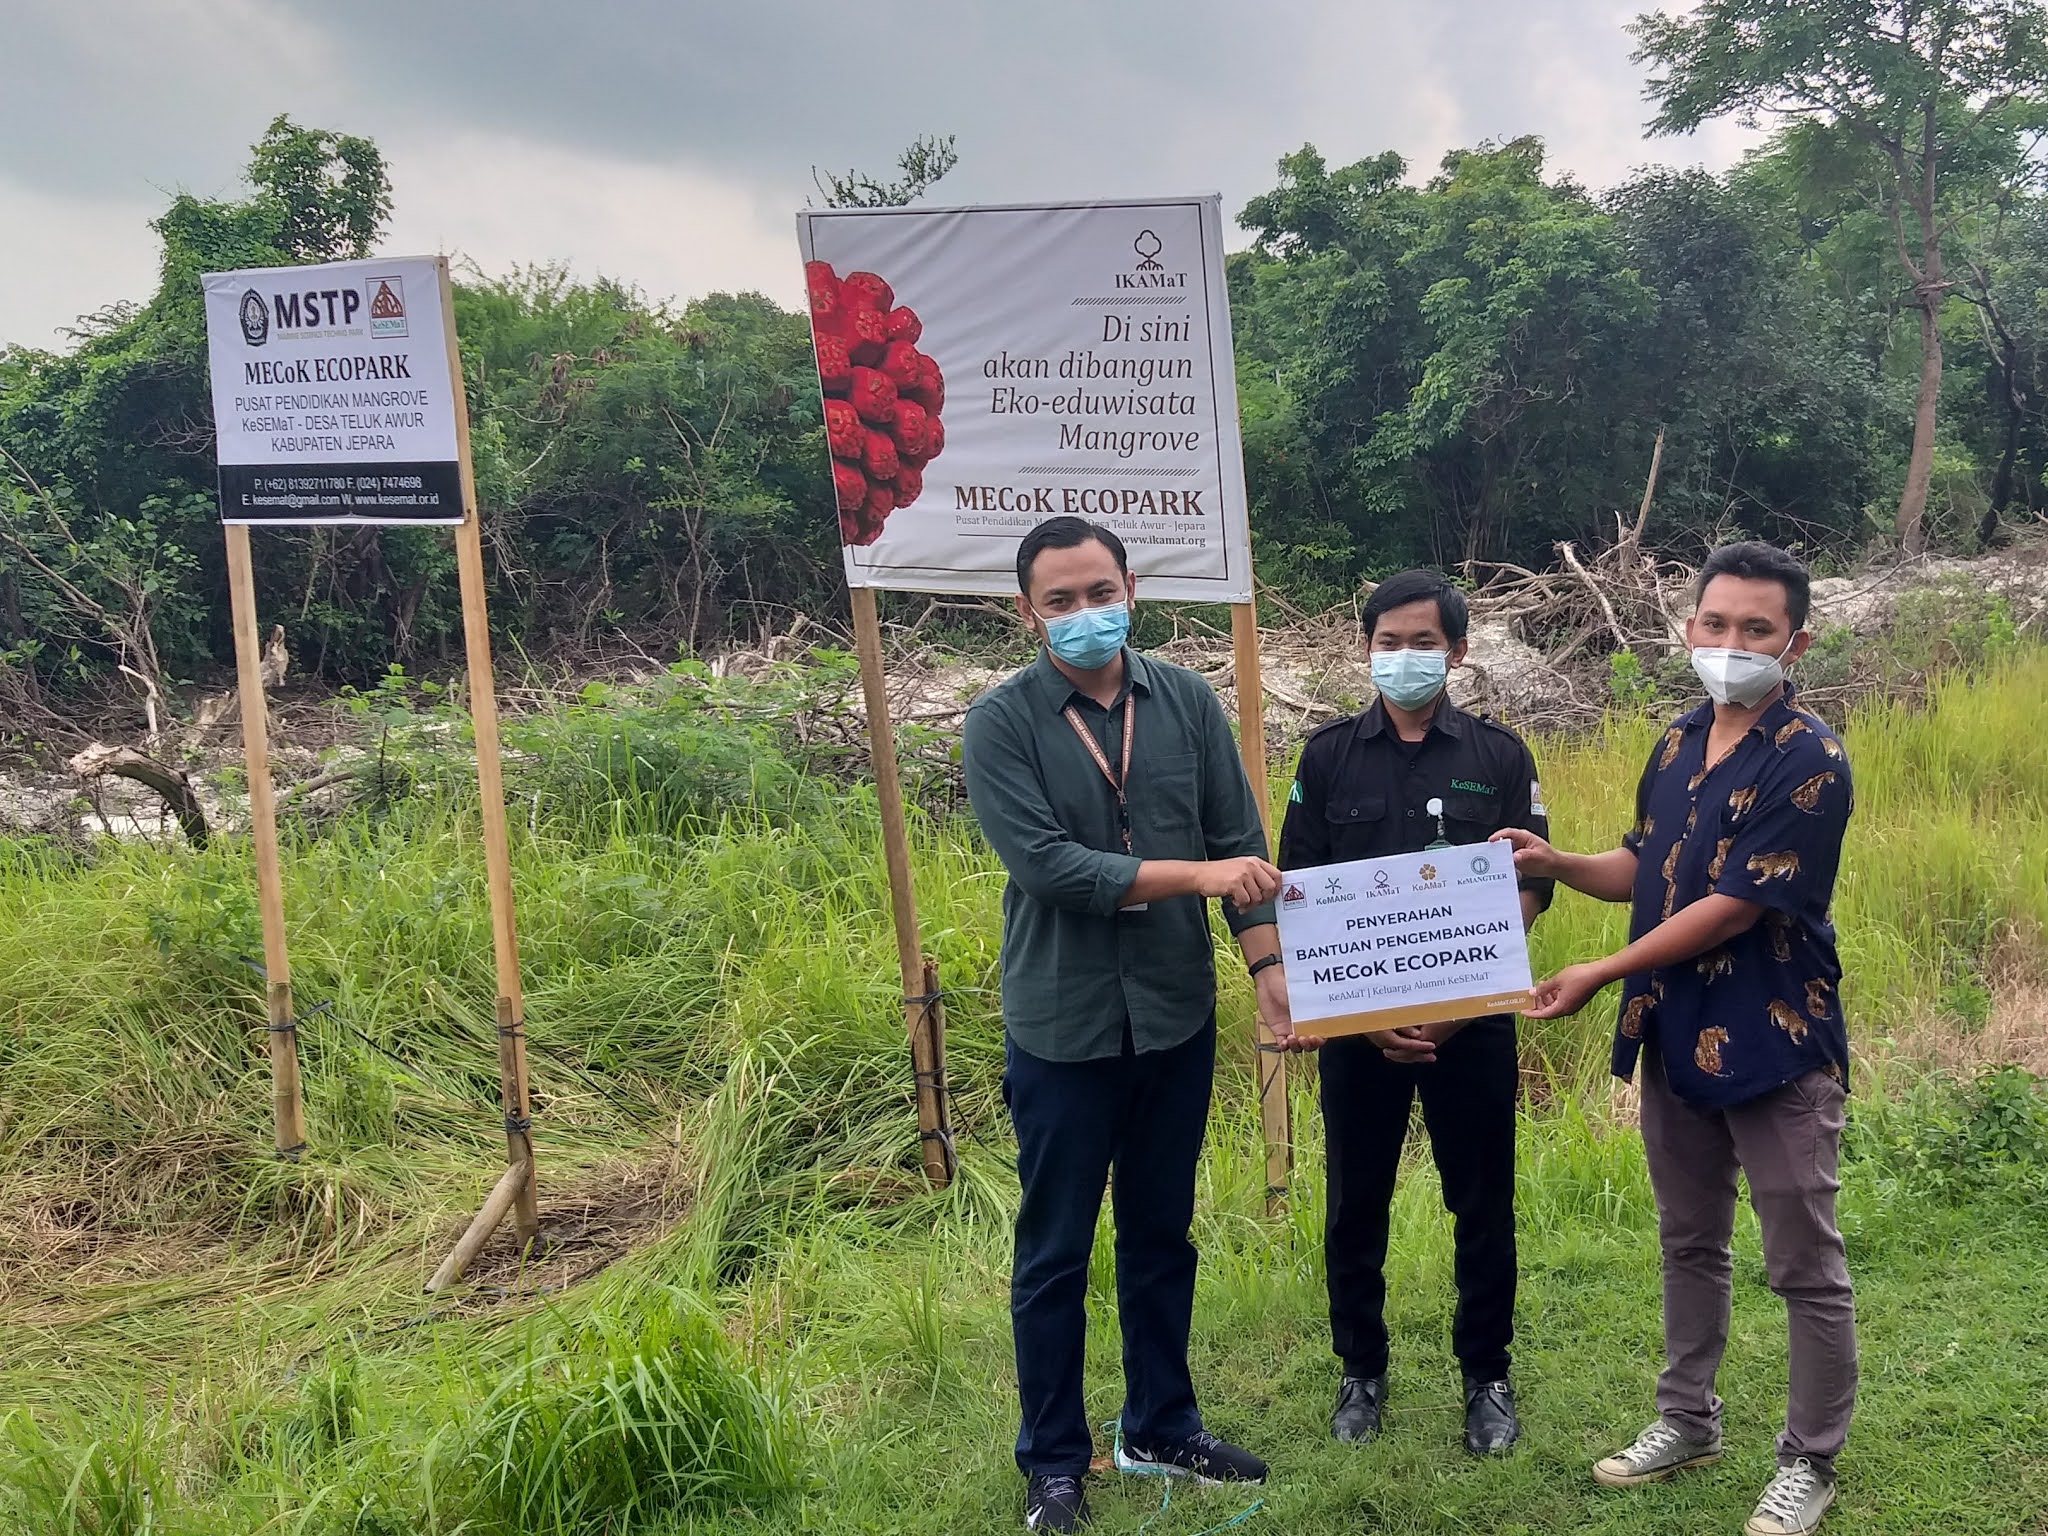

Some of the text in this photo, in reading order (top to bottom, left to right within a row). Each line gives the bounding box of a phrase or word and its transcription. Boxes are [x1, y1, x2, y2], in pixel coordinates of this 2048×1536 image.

[1115, 273, 1188, 289] IKAMaT
[274, 289, 360, 329] MSTP
[1102, 314, 1190, 342] Di sini
[245, 354, 411, 385] MECoK ECOPARK
[983, 350, 1193, 387] akan dibangun
[235, 390, 429, 411] PUSAT PENDIDIKAN MANGROVE
[991, 387, 1196, 415] Eko-eduwisata
[242, 416, 294, 432] KeSEMaT
[305, 415, 339, 430] DESA
[340, 413, 382, 429] TELUK
[384, 412, 425, 428] AWUR
[271, 434, 395, 452] KABUPATEN JEPARA
[1058, 423, 1200, 458] Mangrove
[264, 478, 287, 492] (+62)
[356, 477, 381, 491] (024)
[382, 476, 422, 489] 7474698
[252, 493, 340, 508] kesemat@gmail.com
[355, 493, 439, 505] www.kesemat.or.id
[954, 486, 1205, 516] MECoK ECOPARK
[956, 515, 980, 526] Pusat
[982, 516, 1033, 527] Pendidikan
[1112, 519, 1138, 530] Teluk
[1140, 520, 1167, 530] Awur
[1174, 520, 1206, 532] Jepara
[1450, 779, 1498, 795] KeSEMaT
[1412, 880, 1447, 892] KeAMaT
[1457, 873, 1507, 885] KeMANGTEER
[1316, 893, 1357, 906] KeMANGI
[1366, 886, 1400, 898] IKAMaT
[1346, 905, 1453, 931] PENYERAHAN
[1296, 920, 1509, 961] BANTUAN PENGEMBANGAN
[1313, 944, 1499, 985] MECoK ECOPARK
[1328, 988, 1366, 1002] KeAMaT
[1372, 982, 1412, 996] Keluarga
[1414, 978, 1446, 990] Alumni
[1447, 971, 1490, 986] KeSEMaT
